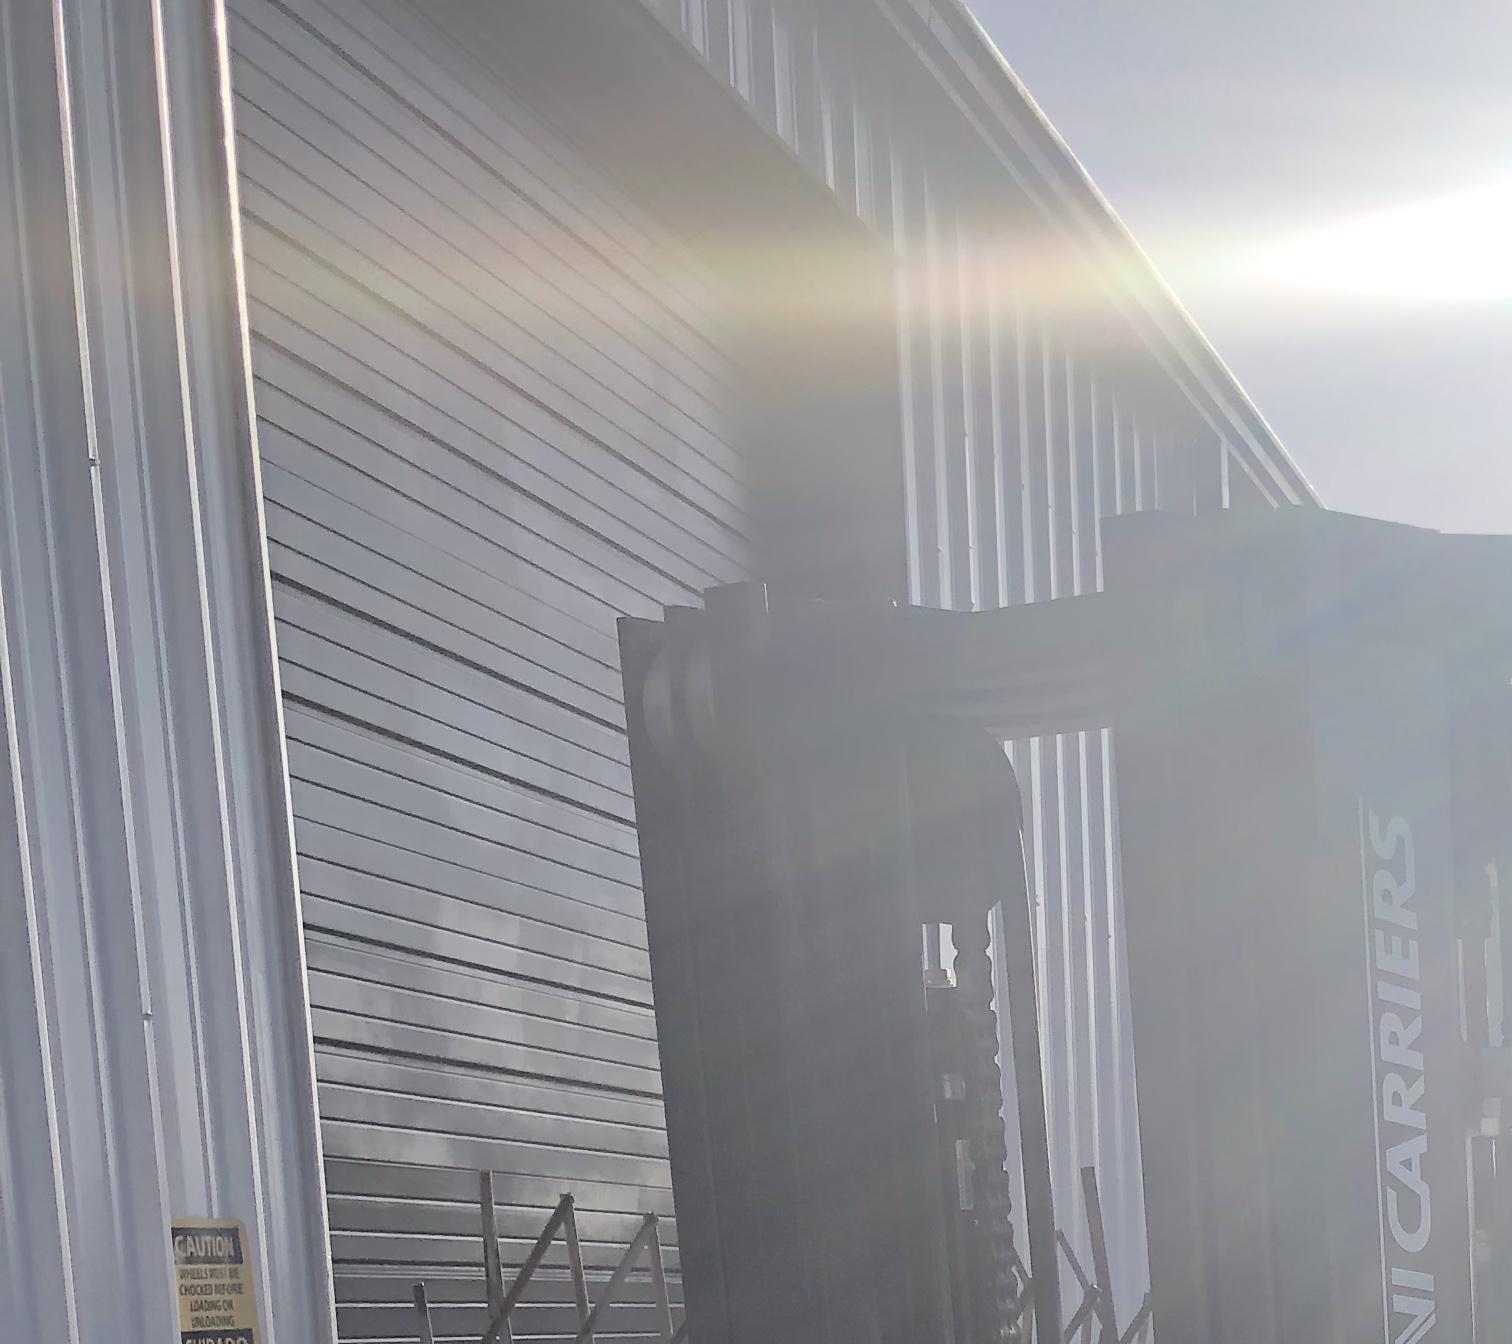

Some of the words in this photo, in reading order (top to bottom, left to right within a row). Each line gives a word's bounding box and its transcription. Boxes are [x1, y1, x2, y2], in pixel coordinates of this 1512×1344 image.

[174, 1233, 235, 1258] CAUTION
[179, 1267, 208, 1280] WHEELS
[228, 1267, 240, 1279] BE
[179, 1283, 213, 1296] CHOCKED
[214, 1282, 244, 1295] BEFORE
[190, 1299, 221, 1312] LOADING
[223, 1299, 234, 1311] OR
[191, 1315, 235, 1328] UNLOADING
